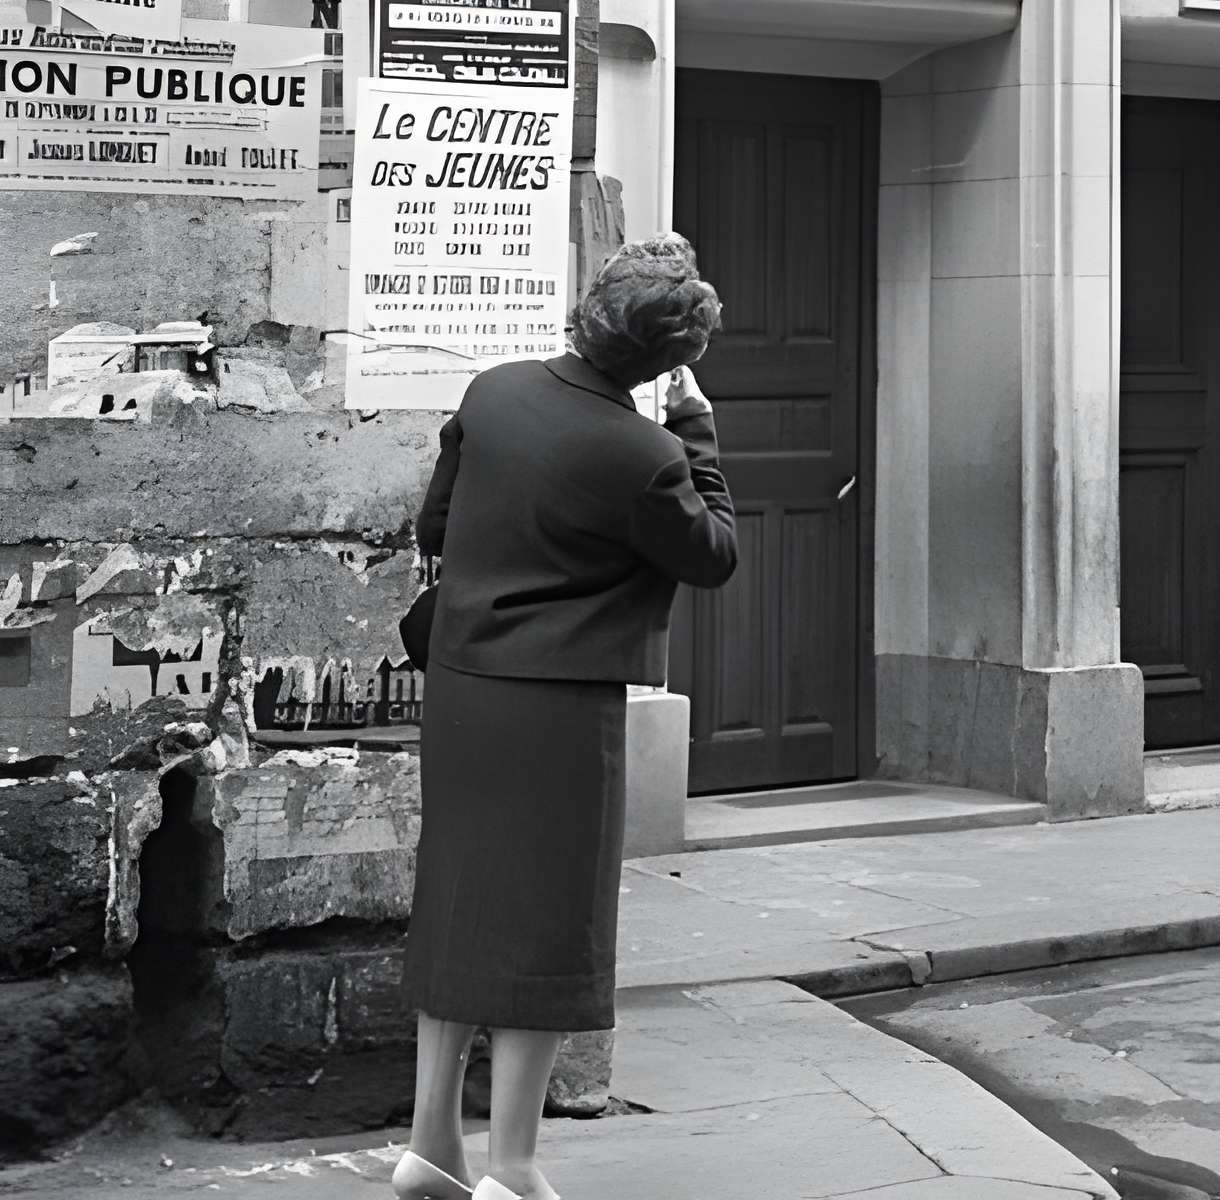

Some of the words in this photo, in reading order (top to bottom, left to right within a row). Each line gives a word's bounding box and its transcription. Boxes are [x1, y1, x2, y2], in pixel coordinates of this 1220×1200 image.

[105, 65, 305, 108] PUBLIQUE
[426, 106, 559, 146] CENTRE
[425, 152, 556, 190] JEUNES
